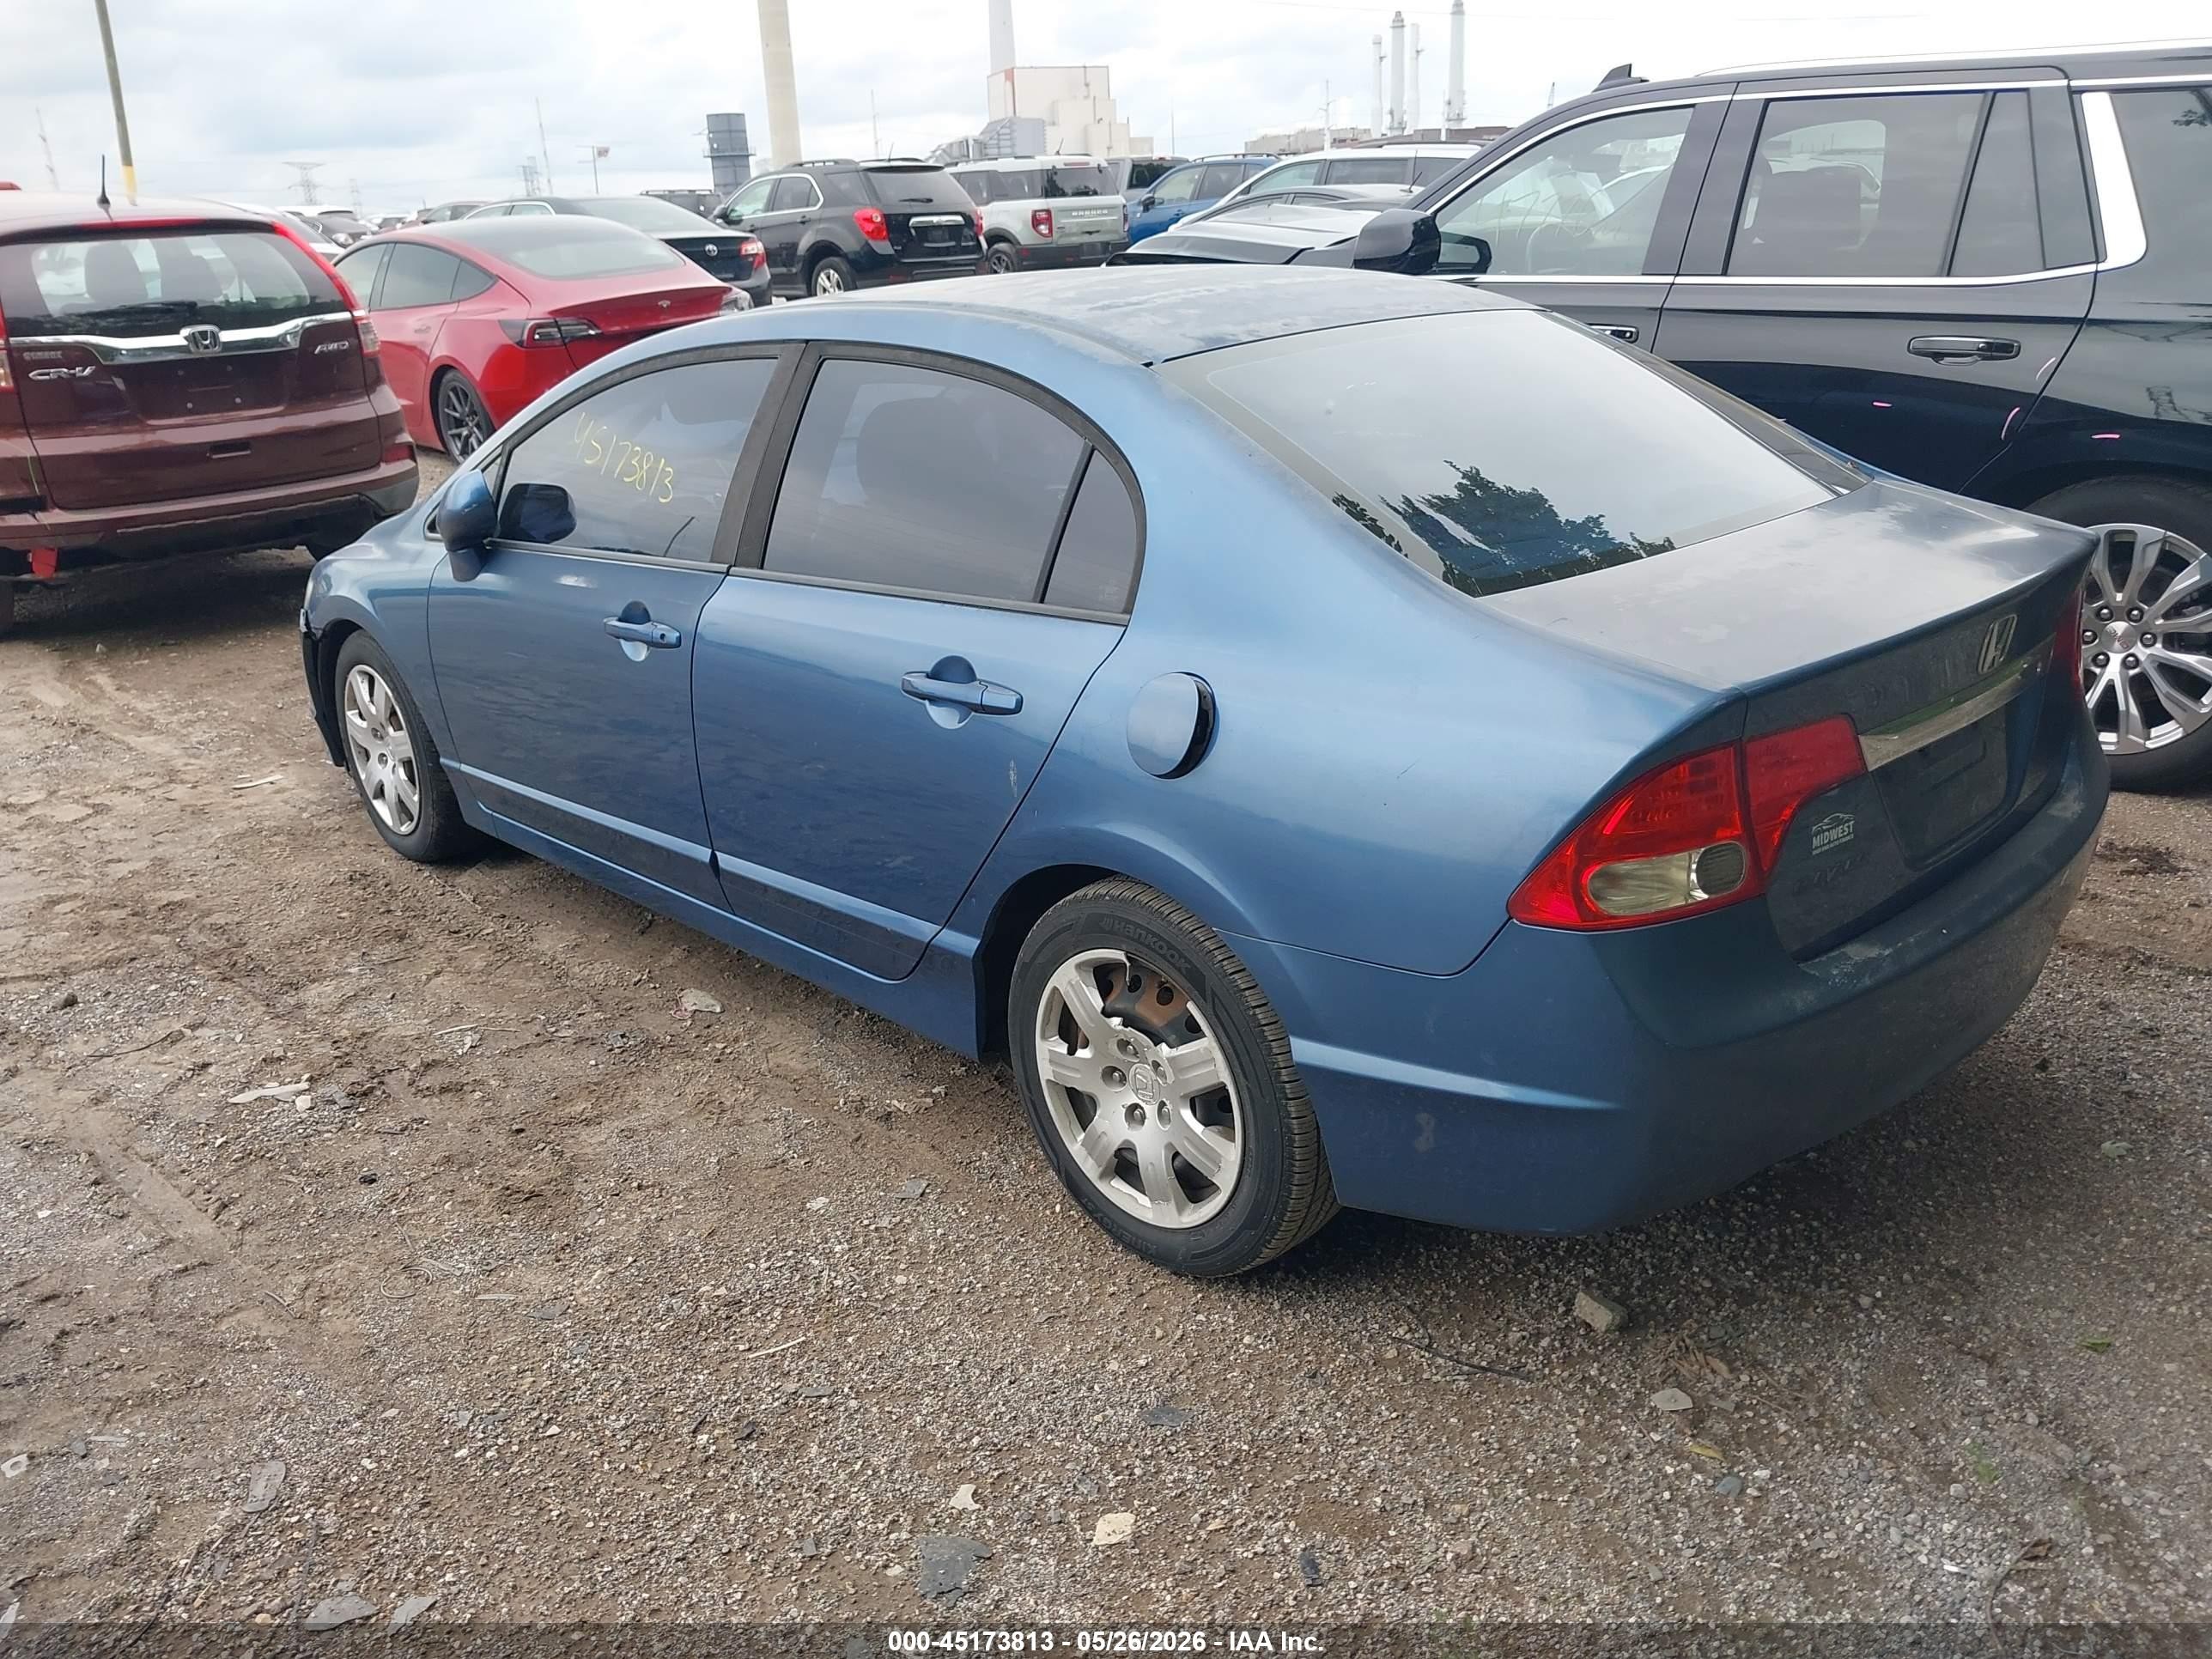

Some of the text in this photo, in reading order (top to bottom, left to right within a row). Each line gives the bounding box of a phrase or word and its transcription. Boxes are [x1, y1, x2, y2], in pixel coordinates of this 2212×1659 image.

[27, 365, 96, 380] CR-V
[574, 411, 674, 503] 45173813
[1812, 823, 1855, 849] MIDWEST
